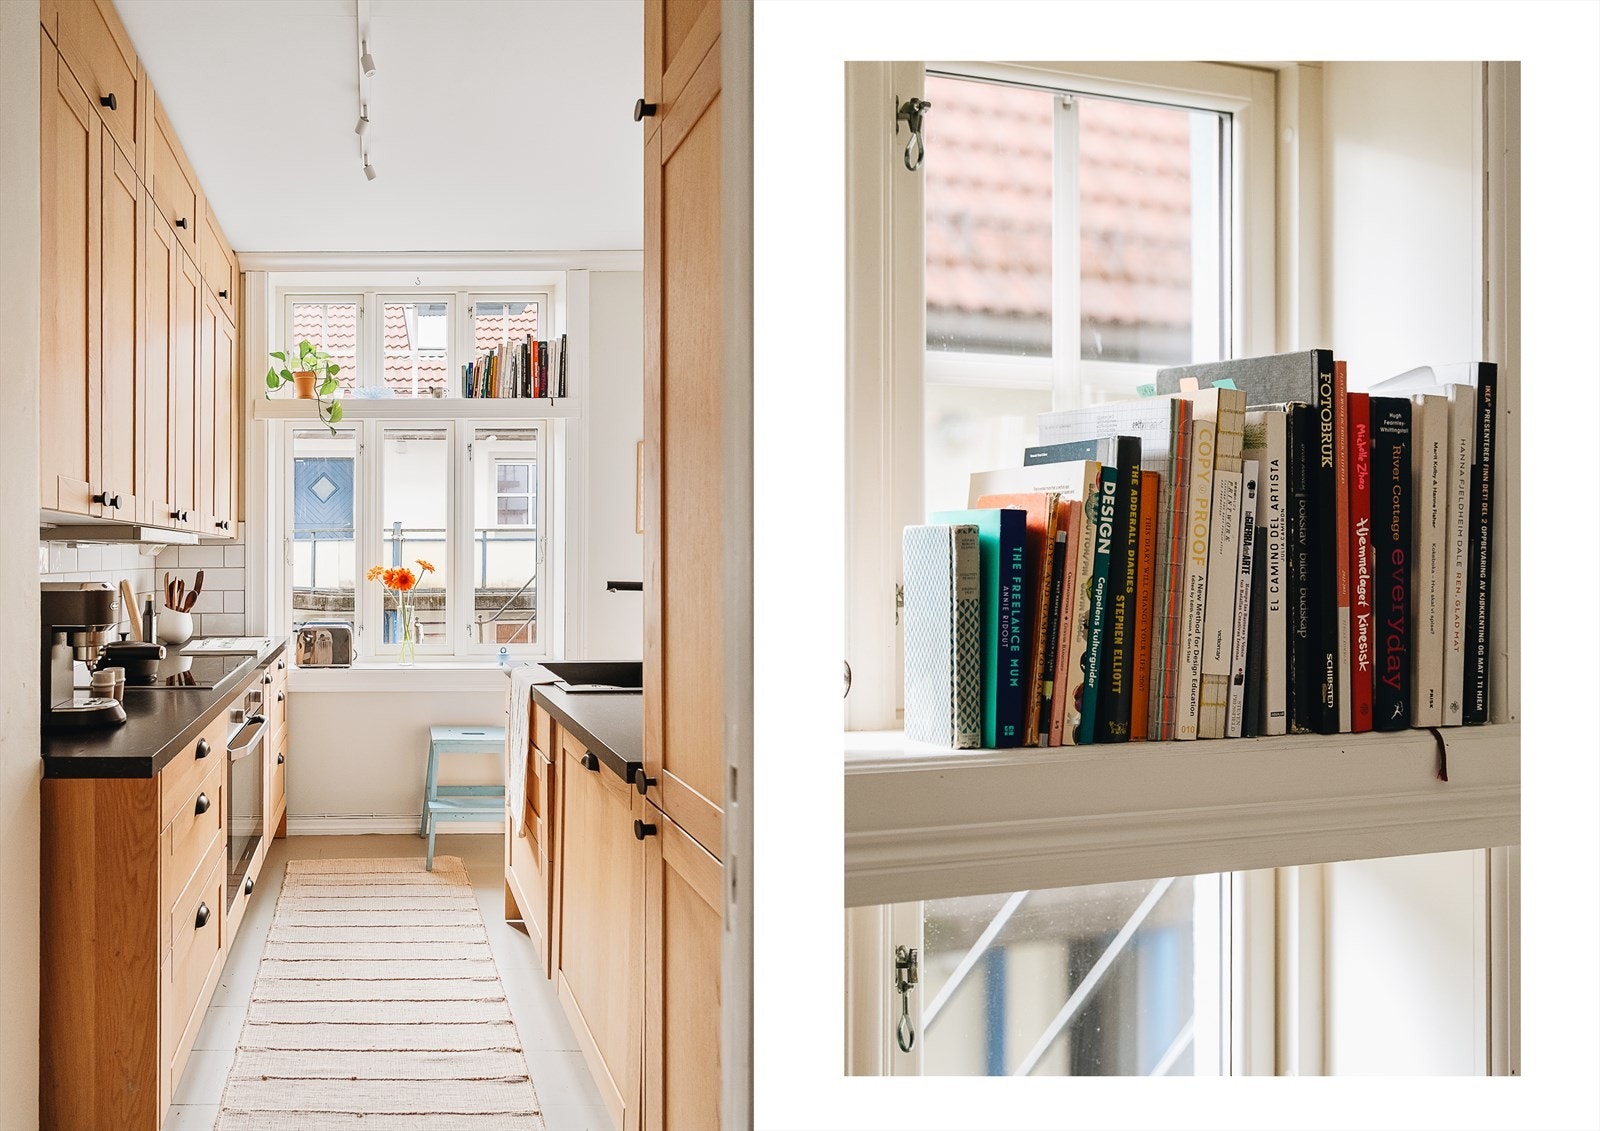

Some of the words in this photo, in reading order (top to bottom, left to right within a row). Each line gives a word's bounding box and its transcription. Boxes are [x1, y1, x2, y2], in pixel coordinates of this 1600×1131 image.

[1320, 372, 1333, 468] FOTOBRUK
[1390, 412, 1402, 420] Hugh
[1482, 409, 1491, 462] PRESENTERER
[1196, 429, 1213, 483] COPY
[1357, 424, 1368, 462] Michelle
[1392, 445, 1402, 481] River
[1131, 465, 1140, 485] THE
[1270, 460, 1279, 510] ARTISTA
[1356, 463, 1368, 490] Zhao
[1098, 481, 1116, 554] DESIGN
[1128, 490, 1139, 545] ADDERALL
[1192, 498, 1209, 566] PROOF
[1270, 518, 1279, 538] DEL
[1298, 500, 1309, 545] bokstav
[1391, 485, 1402, 540] Cottage
[1012, 547, 1022, 569] THE
[1126, 550, 1135, 594] DIARIES
[1270, 544, 1279, 593] CAMINO
[1298, 553, 1308, 581] bilde
[1357, 518, 1370, 607] Hjemmelaget
[1480, 526, 1488, 578] OPPBEVARING
[1142, 567, 1150, 588] WILL
[1480, 580, 1486, 590] AV
[1010, 577, 1021, 651] FREELANCE
[1094, 577, 1106, 626] Cappelens
[1114, 595, 1125, 644] STEPHEN
[1194, 604, 1203, 634] Method
[1270, 601, 1279, 611] EL
[1297, 588, 1308, 638] budskap
[1382, 548, 1405, 690] everyday
[1478, 592, 1486, 643] KJØKKENTING
[1040, 604, 1048, 645] GAMES
[1194, 636, 1202, 648] for
[1357, 614, 1370, 671] kinesisk
[1039, 650, 1045, 666] TO
[1088, 629, 1101, 688] kulturguider
[1112, 650, 1123, 694] ELLIOTT
[1192, 650, 1200, 676] Design
[1478, 645, 1485, 656] OG
[1010, 659, 1019, 687] MUM
[1190, 679, 1198, 717] Education
